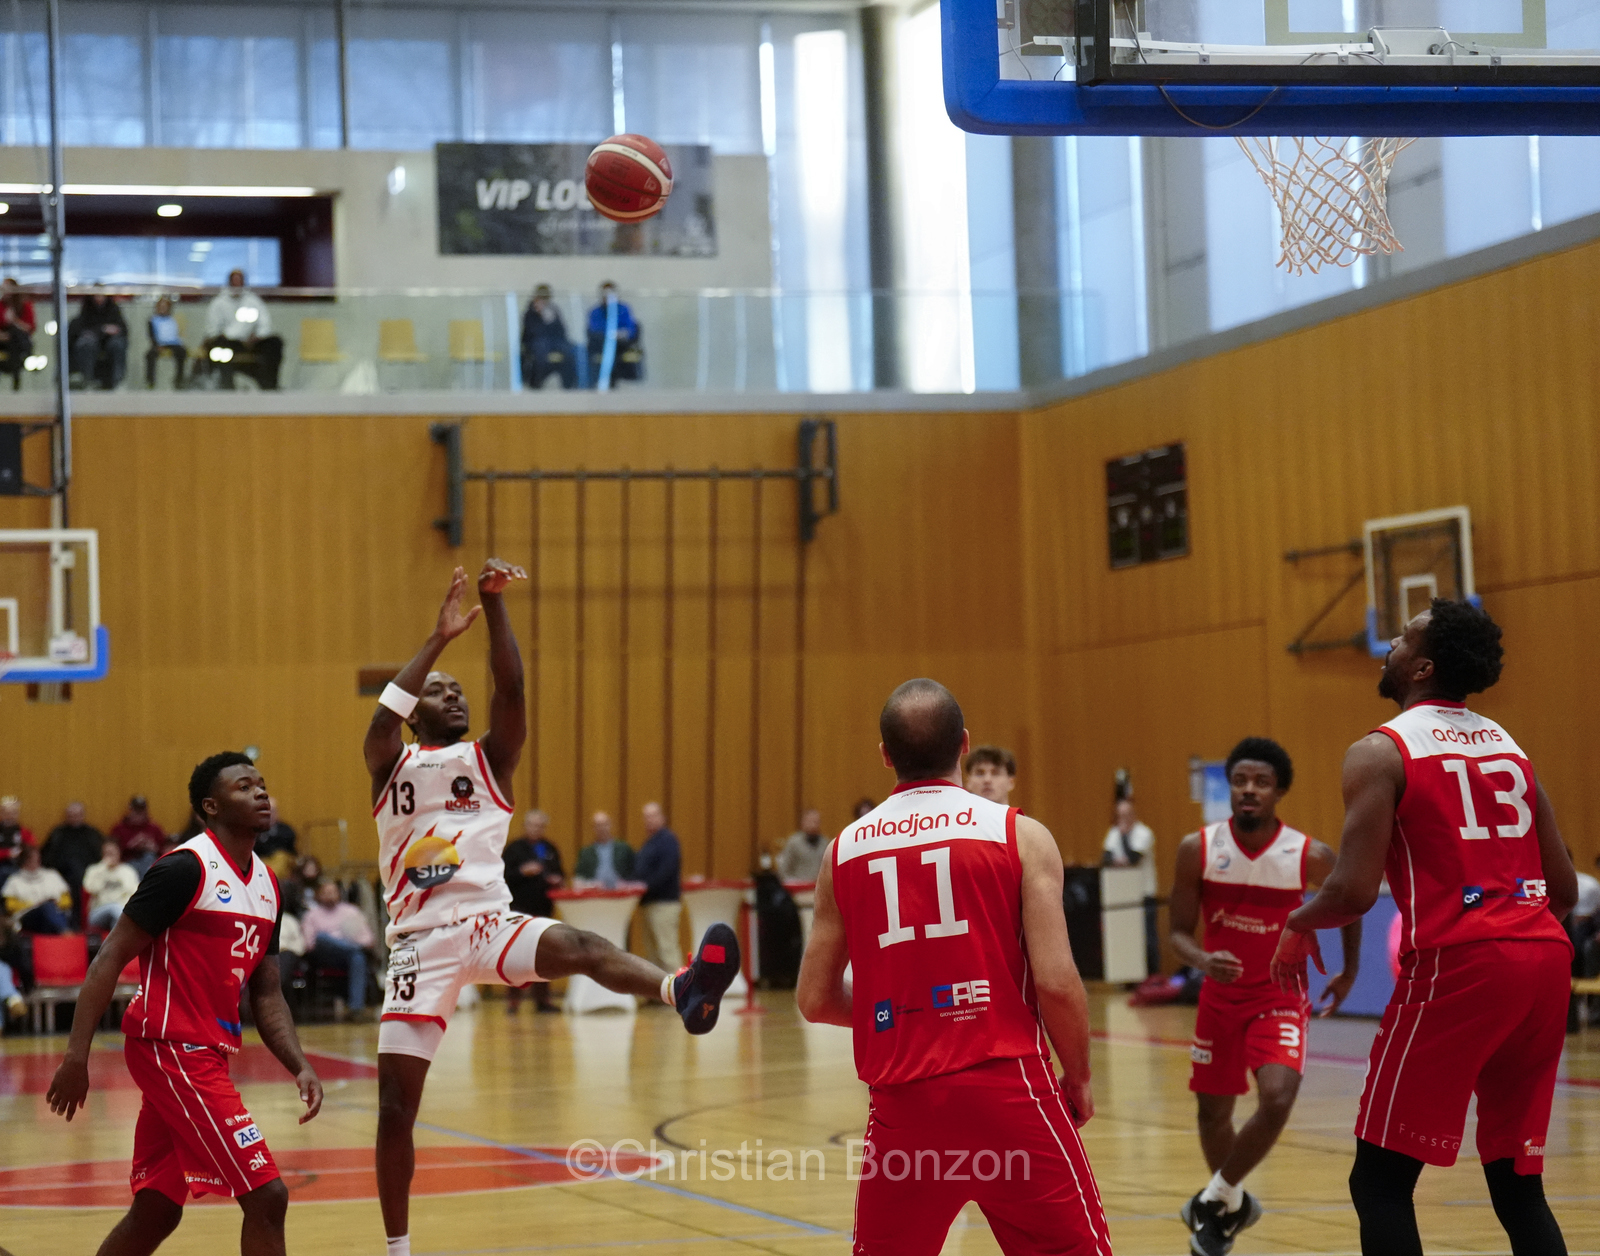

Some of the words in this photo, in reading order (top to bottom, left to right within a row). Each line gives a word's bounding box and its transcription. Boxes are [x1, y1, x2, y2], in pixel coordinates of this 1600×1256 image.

[476, 179, 532, 211] VIP
[534, 179, 597, 211] LOU
[1432, 726, 1503, 745] adams
[391, 781, 416, 816] 13
[445, 800, 481, 811] LIONS
[1441, 759, 1533, 840] 13
[855, 811, 949, 843] mladjan
[956, 807, 977, 827] d.
[415, 863, 451, 880] SIG
[868, 846, 969, 949] 11
[230, 921, 260, 960] 24
[392, 972, 417, 1001] 13
[931, 979, 991, 1009] GAE
[940, 1009, 965, 1018] GIOVANNI
[1279, 1022, 1300, 1047] 3
